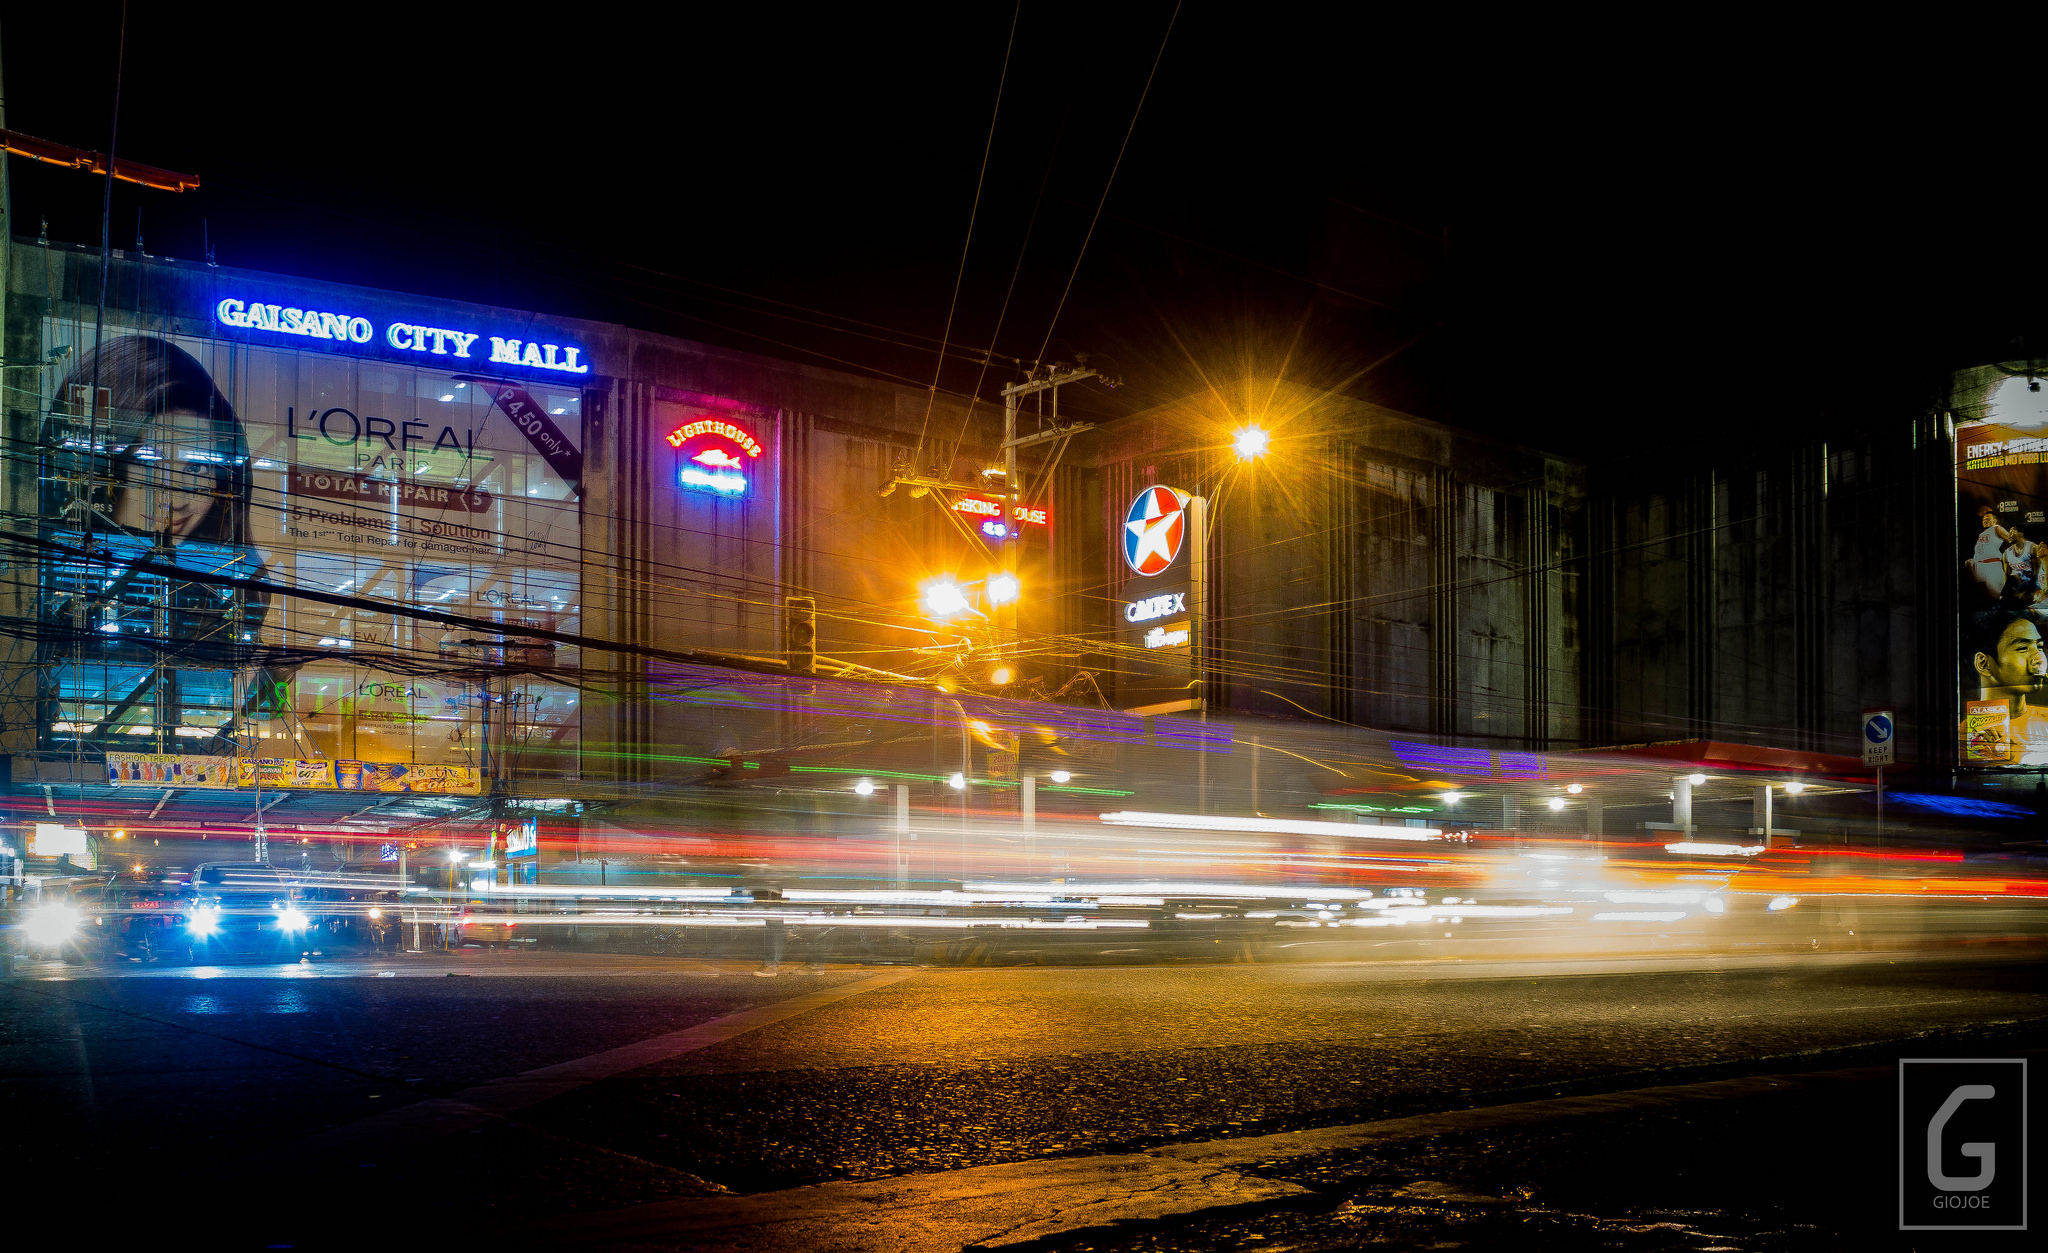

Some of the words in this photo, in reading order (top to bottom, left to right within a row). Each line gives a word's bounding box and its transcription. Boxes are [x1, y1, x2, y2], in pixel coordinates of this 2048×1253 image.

[217, 298, 373, 343] GAISANO
[386, 322, 479, 358] CITY
[488, 336, 588, 374] MALL
[498, 388, 515, 401] P
[508, 401, 543, 436] 4.50
[287, 406, 495, 462] L'ORÉAL
[665, 420, 762, 458] LIGHTHOUSE
[1966, 456, 2004, 471] KATULONG
[2005, 454, 2018, 466] MO
[2018, 453, 2039, 465] PARA
[1967, 441, 2003, 460] ENERGY
[301, 474, 371, 495] TOTAL
[378, 483, 449, 503] REPAIR
[473, 491, 483, 506] 5
[291, 505, 303, 521] 5
[405, 519, 415, 534] 1
[419, 519, 491, 540] Solution
[1012, 507, 1047, 524] OUSE
[289, 527, 309, 539] The
[337, 532, 364, 544] Total
[366, 535, 400, 547] Repair
[403, 539, 419, 548] for
[420, 541, 469, 555] damaged
[109, 753, 146, 762] FASHION
[150, 755, 176, 763] TREND
[1867, 754, 1889, 763] RIGHT
[1868, 745, 1888, 754] KEEP
[407, 764, 473, 780] Festival
